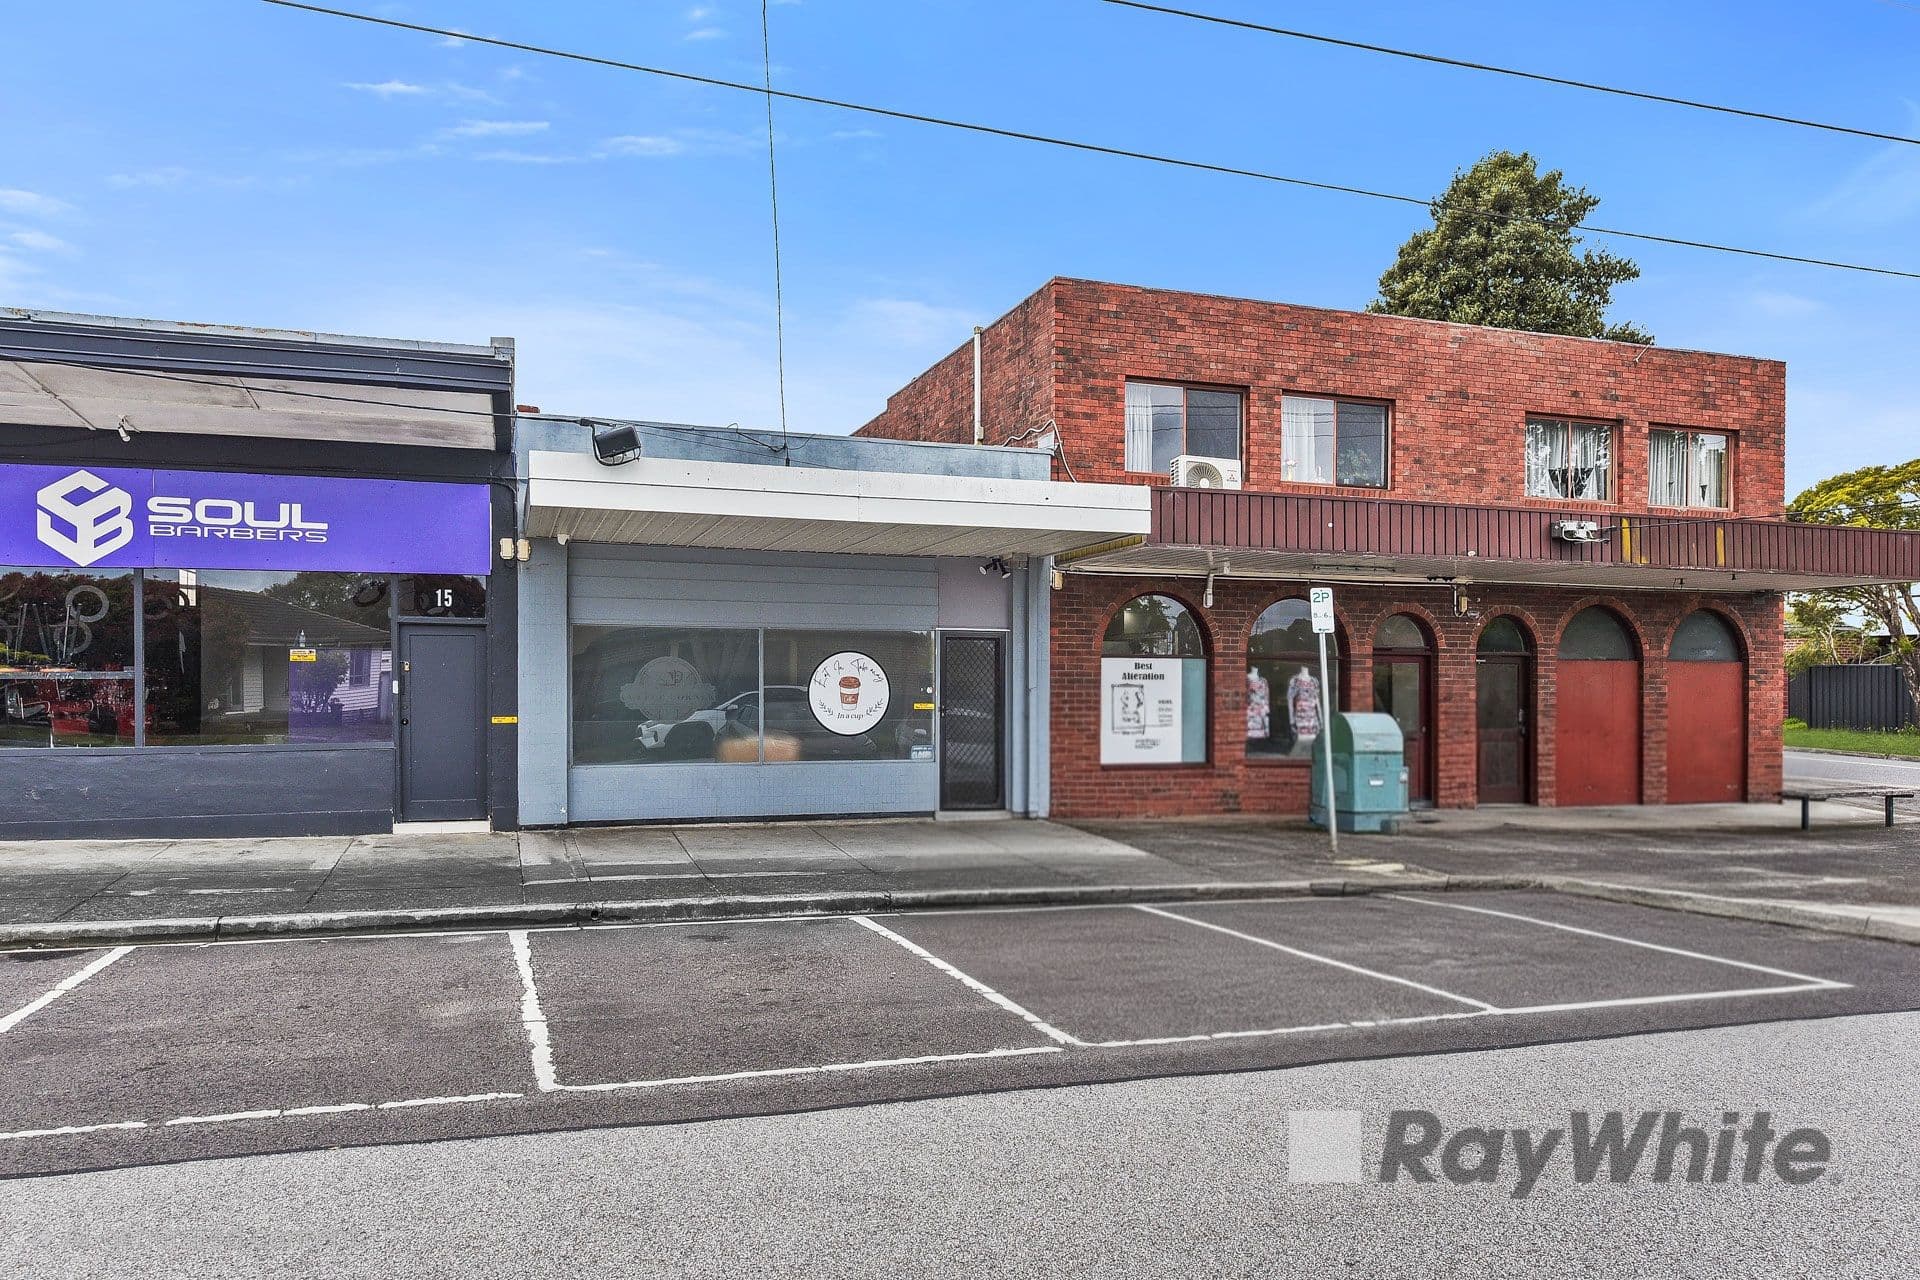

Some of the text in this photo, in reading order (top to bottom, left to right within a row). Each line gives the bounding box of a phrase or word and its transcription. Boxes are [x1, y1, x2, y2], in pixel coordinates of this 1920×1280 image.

[147, 496, 328, 530] SOUL
[150, 524, 328, 543] BARBERS
[435, 588, 452, 607] 15
[1312, 592, 1329, 603] 2P
[1134, 662, 1153, 670] Best
[1121, 672, 1165, 681] Alteration
